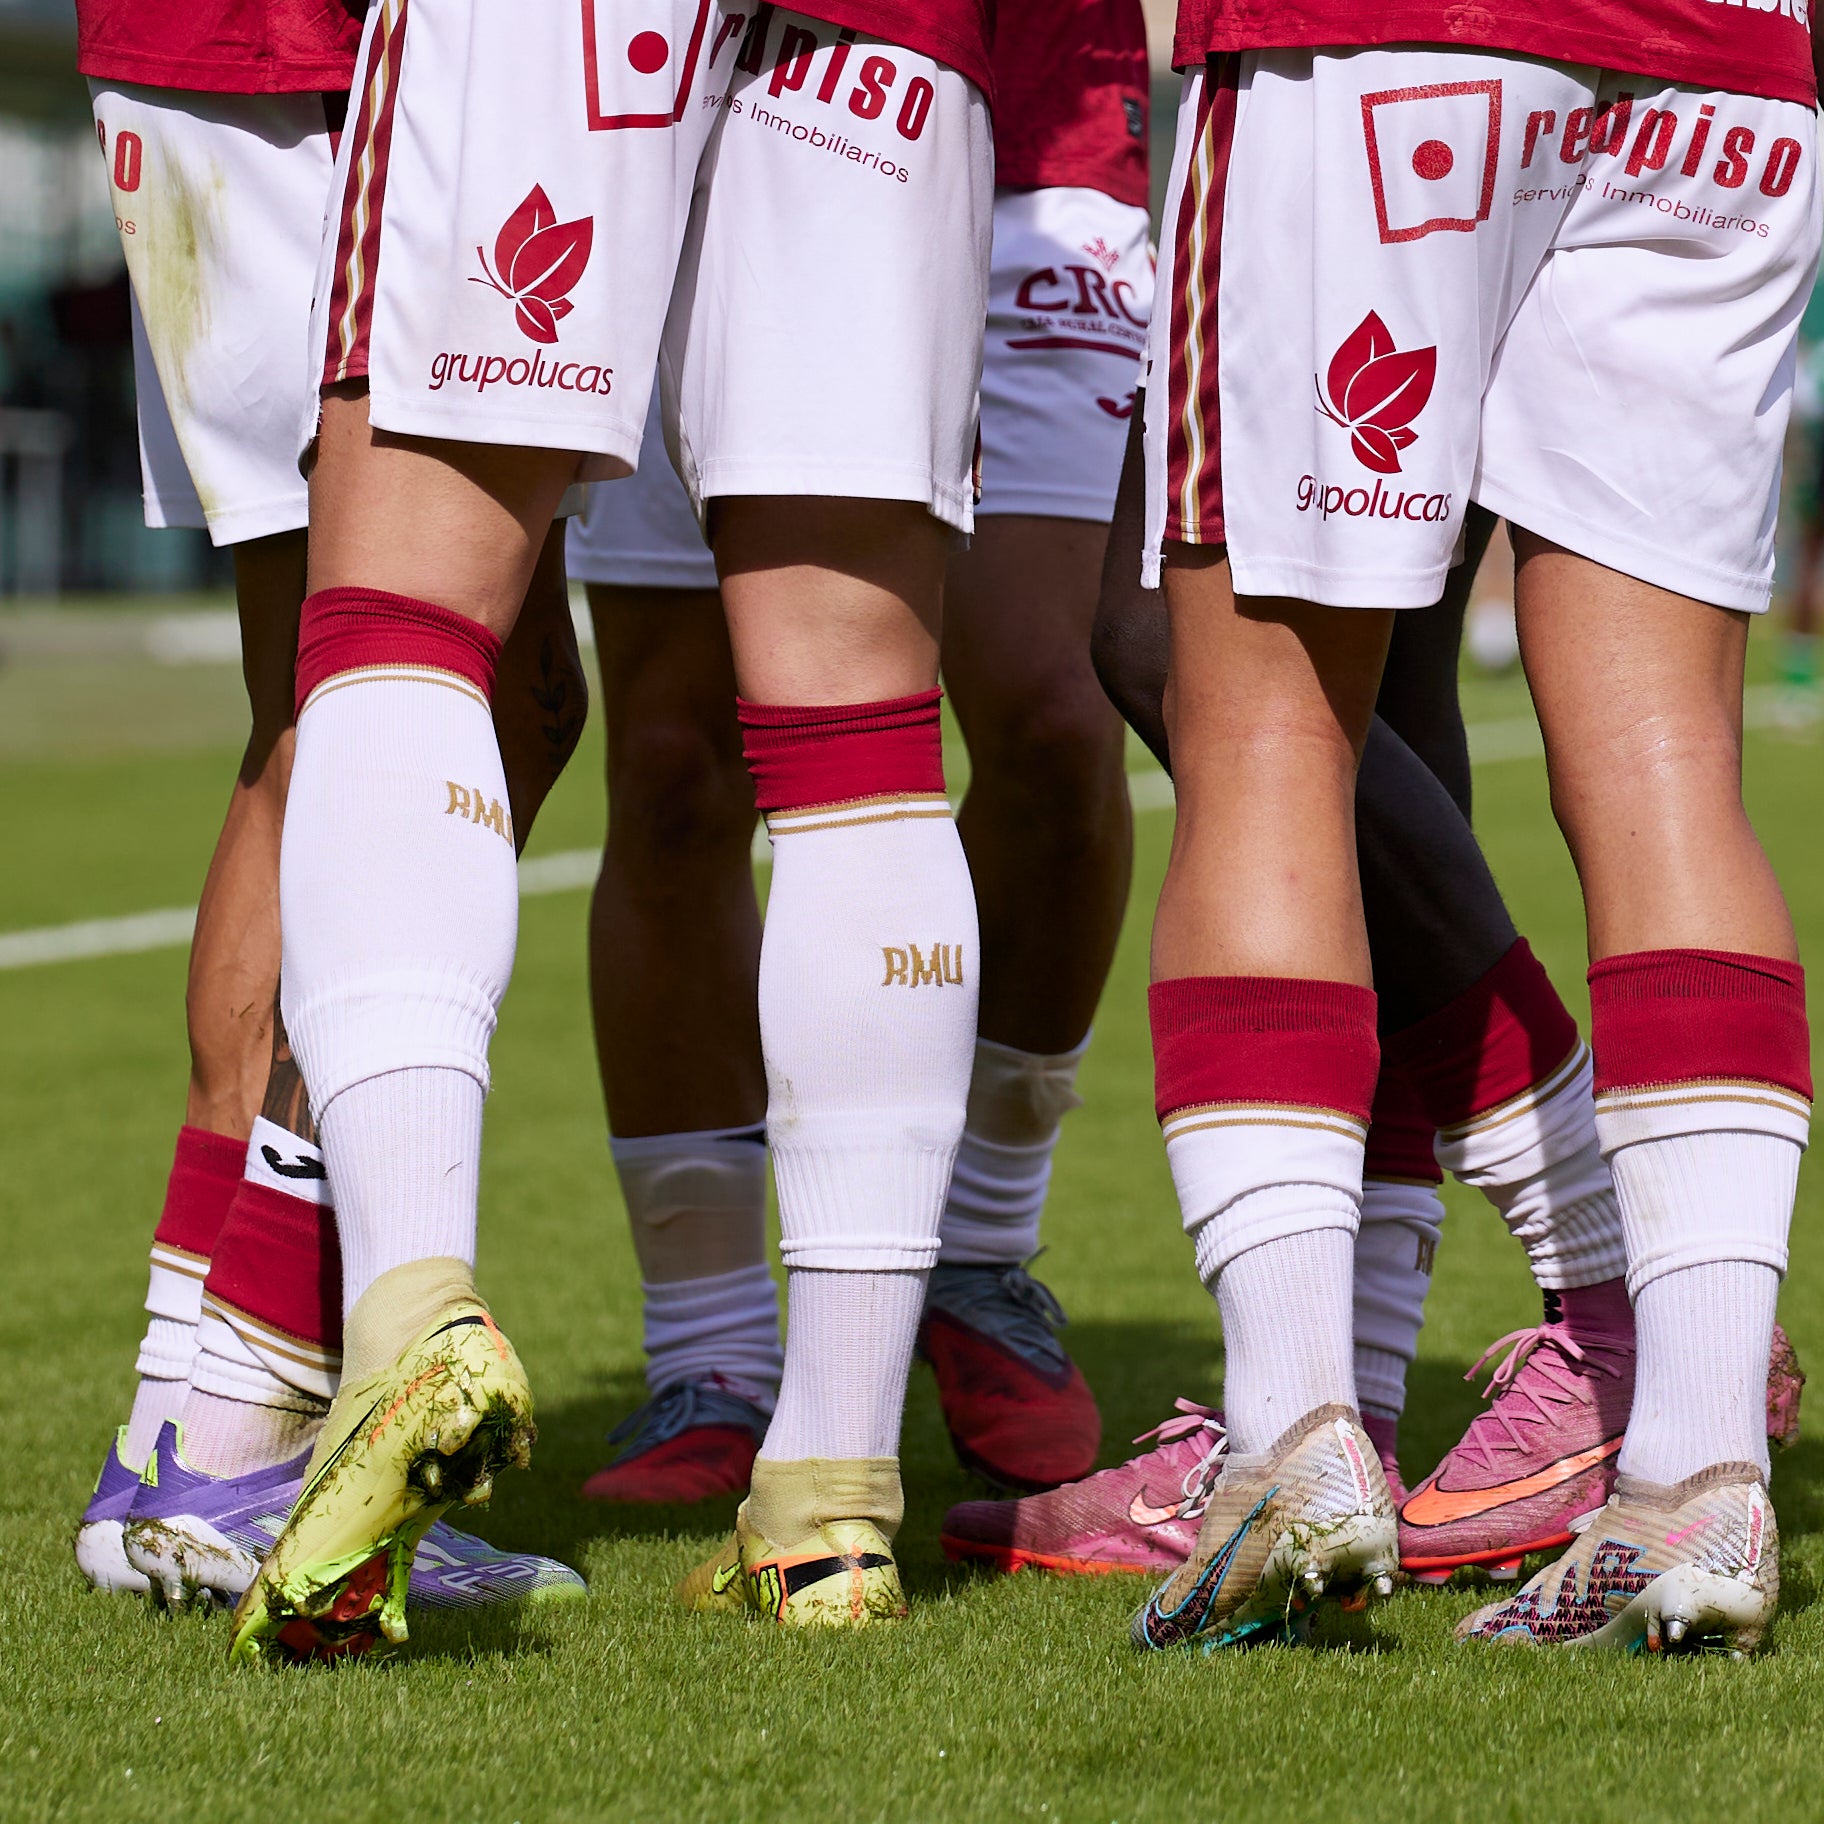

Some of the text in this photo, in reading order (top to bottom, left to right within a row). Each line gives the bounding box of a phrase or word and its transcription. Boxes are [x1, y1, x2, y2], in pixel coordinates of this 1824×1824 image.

[708, 2, 934, 141] rdpiso
[750, 102, 910, 183] Inmobiliarios
[1520, 92, 1803, 198] redpiso
[1602, 181, 1771, 239] Inmobiliarios
[428, 349, 614, 396] grupolucas
[881, 942, 964, 989] RMU
